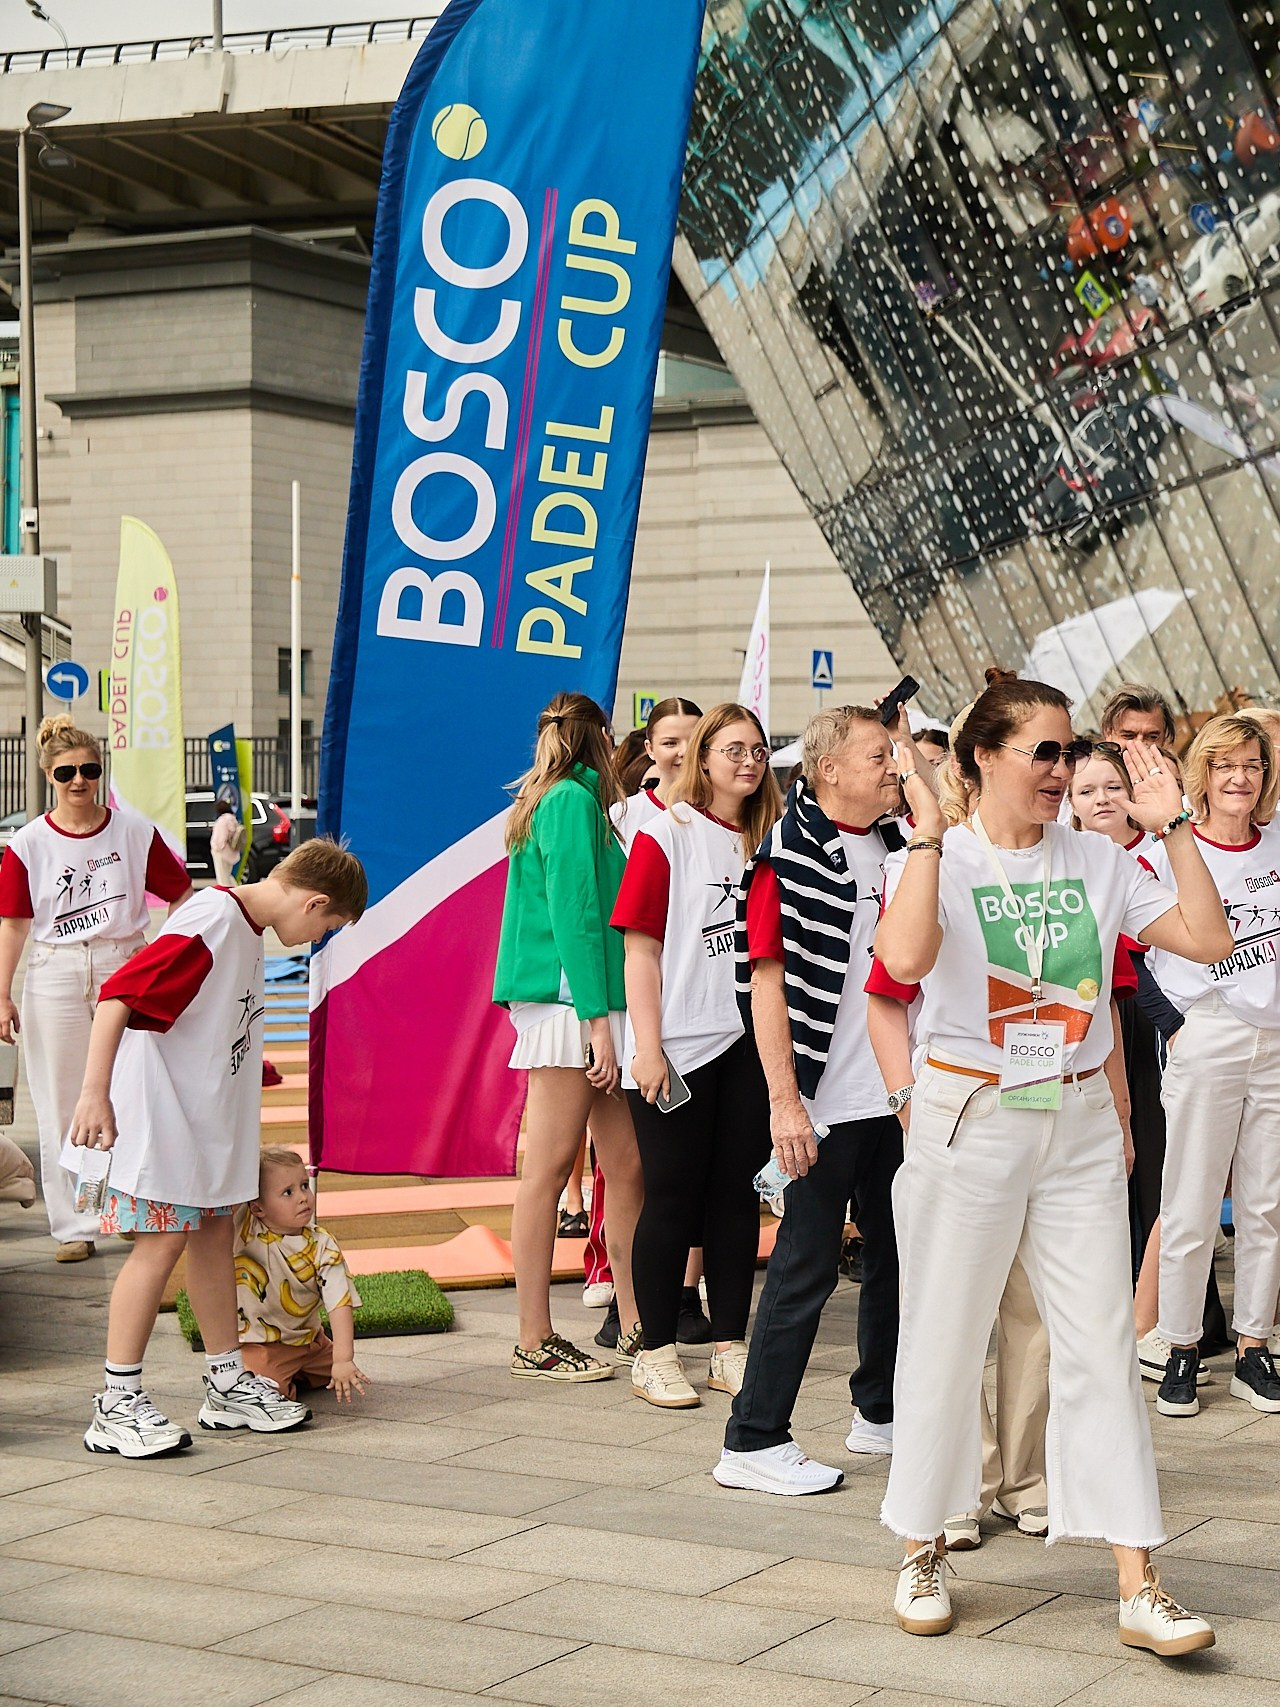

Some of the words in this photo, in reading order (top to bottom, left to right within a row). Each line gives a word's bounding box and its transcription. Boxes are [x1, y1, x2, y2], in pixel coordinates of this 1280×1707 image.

[557, 198, 637, 369] CUP
[376, 178, 529, 647] BOSCO
[516, 405, 615, 659] PADEL
[54, 907, 110, 938] ЗАРЯДКА
[980, 888, 1084, 922] BOSCO
[1208, 940, 1277, 981] ЗАРЯДКА
[1009, 1058, 1034, 1067] PADEL
[1037, 1059, 1055, 1068] CUP
[1010, 1044, 1055, 1057] BOSCO
